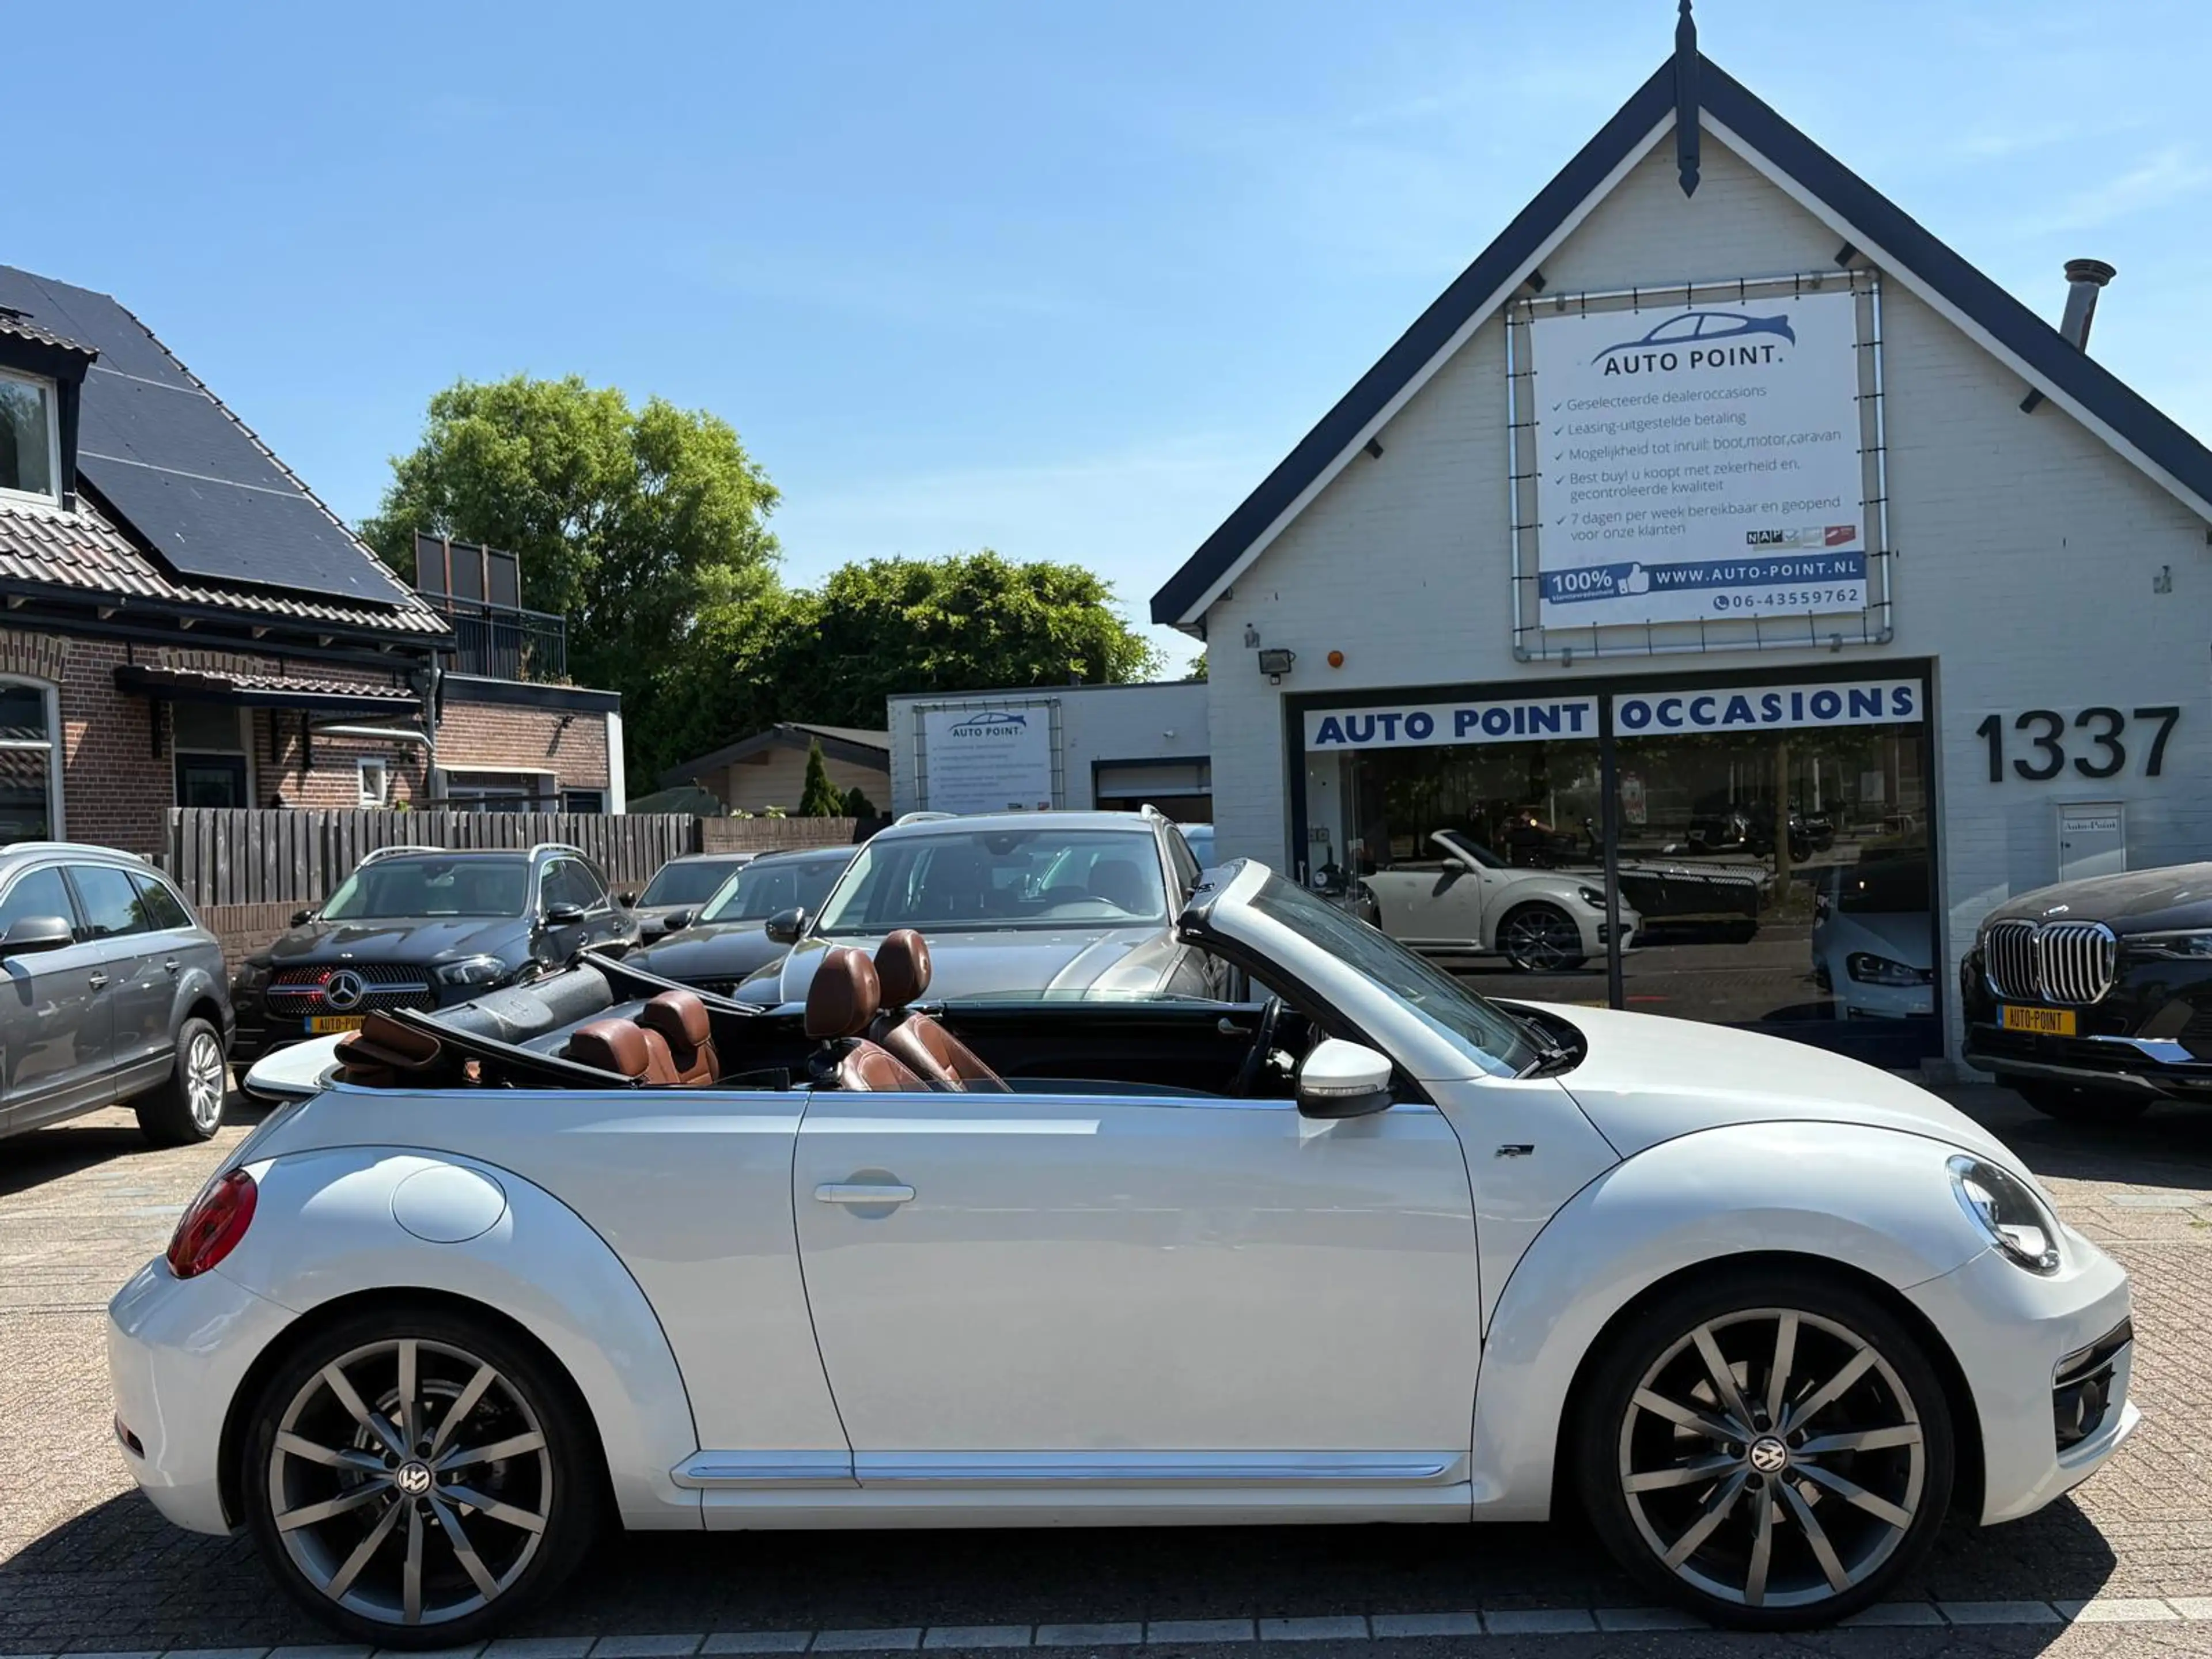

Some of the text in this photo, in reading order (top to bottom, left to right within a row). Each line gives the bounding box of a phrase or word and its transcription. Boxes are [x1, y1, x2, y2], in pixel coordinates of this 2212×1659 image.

[1604, 353, 1678, 376] AUTO
[1567, 387, 1767, 411] Geselecteerde dealeroccasions
[1569, 412, 1747, 435] Leasing-uitgestelde betaling
[1569, 439, 1649, 461] Mogelijkheid
[1652, 442, 1671, 454] tot
[1713, 430, 1842, 451] boot,motor,caravan
[1570, 472, 1599, 485] Best
[1601, 469, 1628, 484] buy!
[1632, 471, 1640, 480] u
[1644, 466, 1680, 480] koopt
[1684, 463, 1710, 476] met
[1714, 459, 1777, 475] zekerheid
[1570, 480, 1724, 504] gecontroleerde kwaliteit
[1571, 495, 1841, 527] 7 dagen per week bereikbaar en geopend
[1571, 523, 1686, 541] voor onze klanten
[1748, 530, 1782, 544] NAP
[1552, 560, 1858, 593] 100% WWW.AUTO-POINT.NL
[1733, 589, 1858, 608] 06-43559762
[1315, 686, 1914, 745] AUTO POINT OCCASIONS
[953, 728, 983, 737] AUTO
[1976, 706, 2180, 782] 1337
[2010, 1007, 2062, 1031] AUTO-POINT
